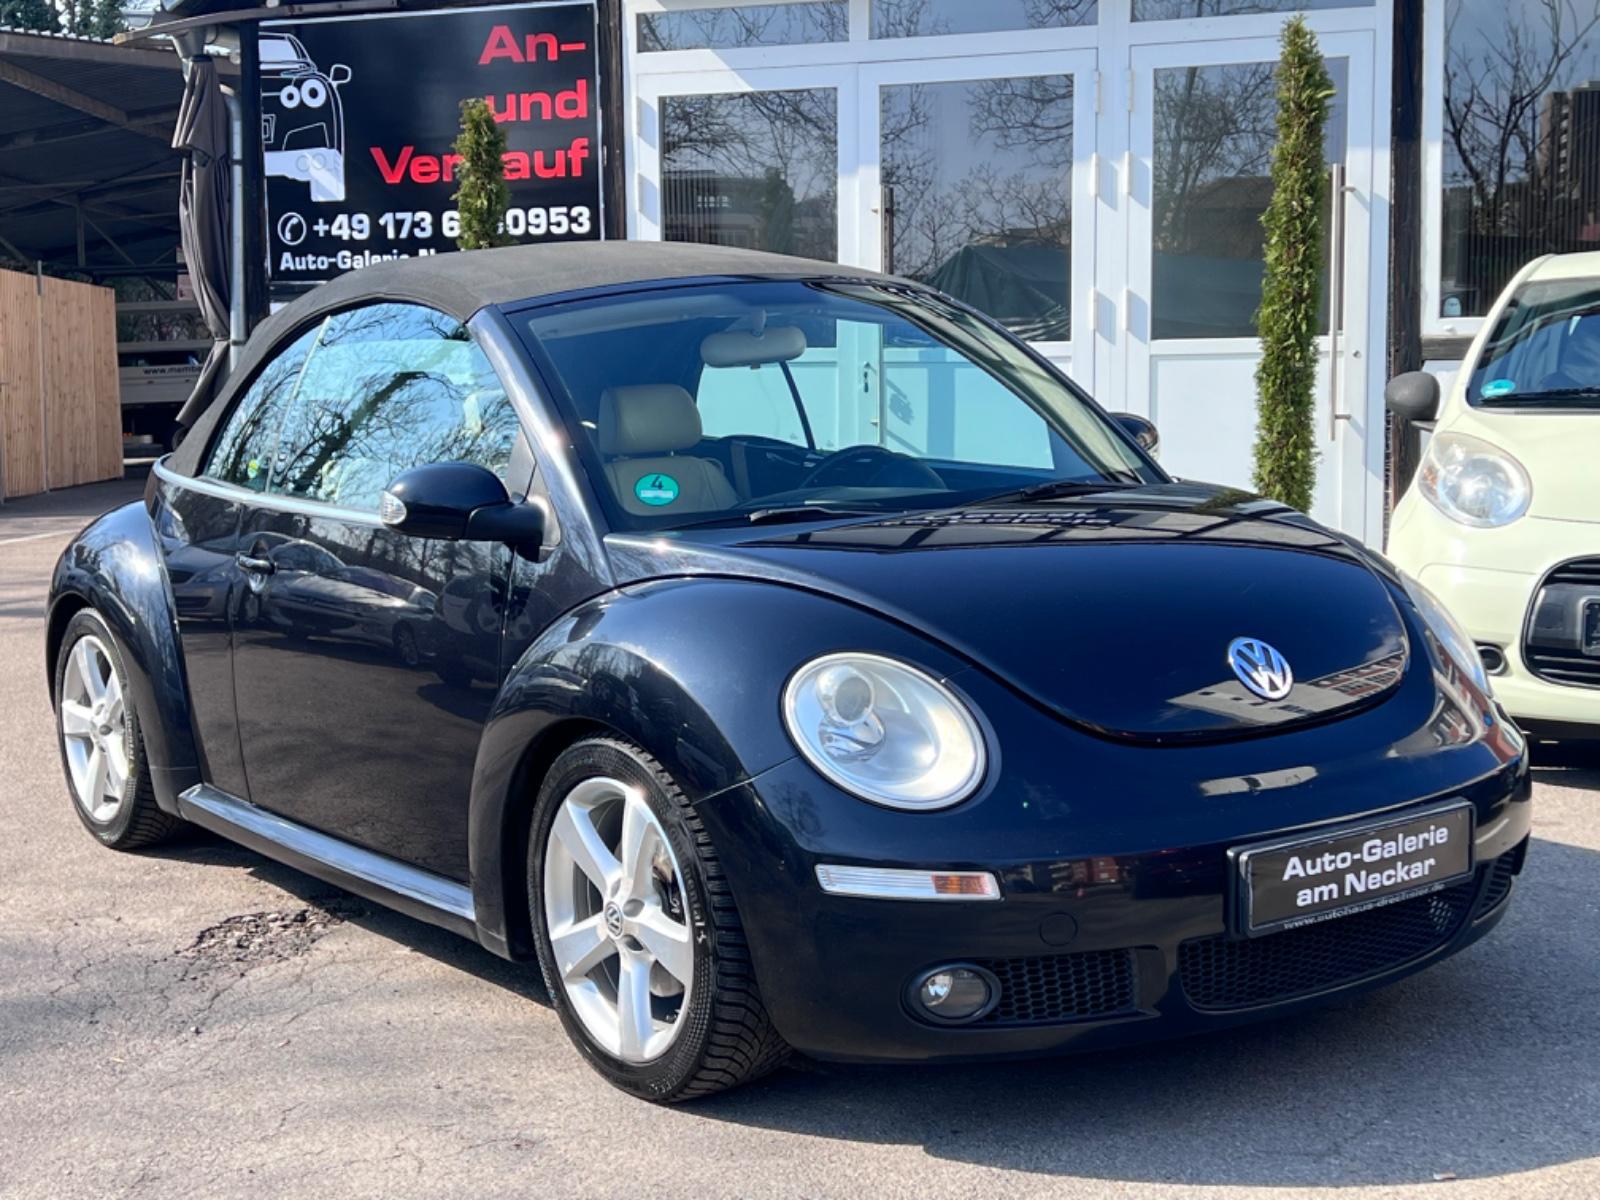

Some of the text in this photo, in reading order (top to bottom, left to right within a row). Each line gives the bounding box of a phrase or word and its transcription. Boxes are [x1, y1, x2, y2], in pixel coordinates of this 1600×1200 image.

[477, 25, 586, 66] An-
[484, 79, 588, 123] und
[370, 138, 589, 184] Verauf
[312, 206, 591, 241] +49 173 60953
[650, 475, 663, 490] 4
[1282, 825, 1449, 881] Auto-Galerie
[1296, 857, 1436, 907] am Neckar
